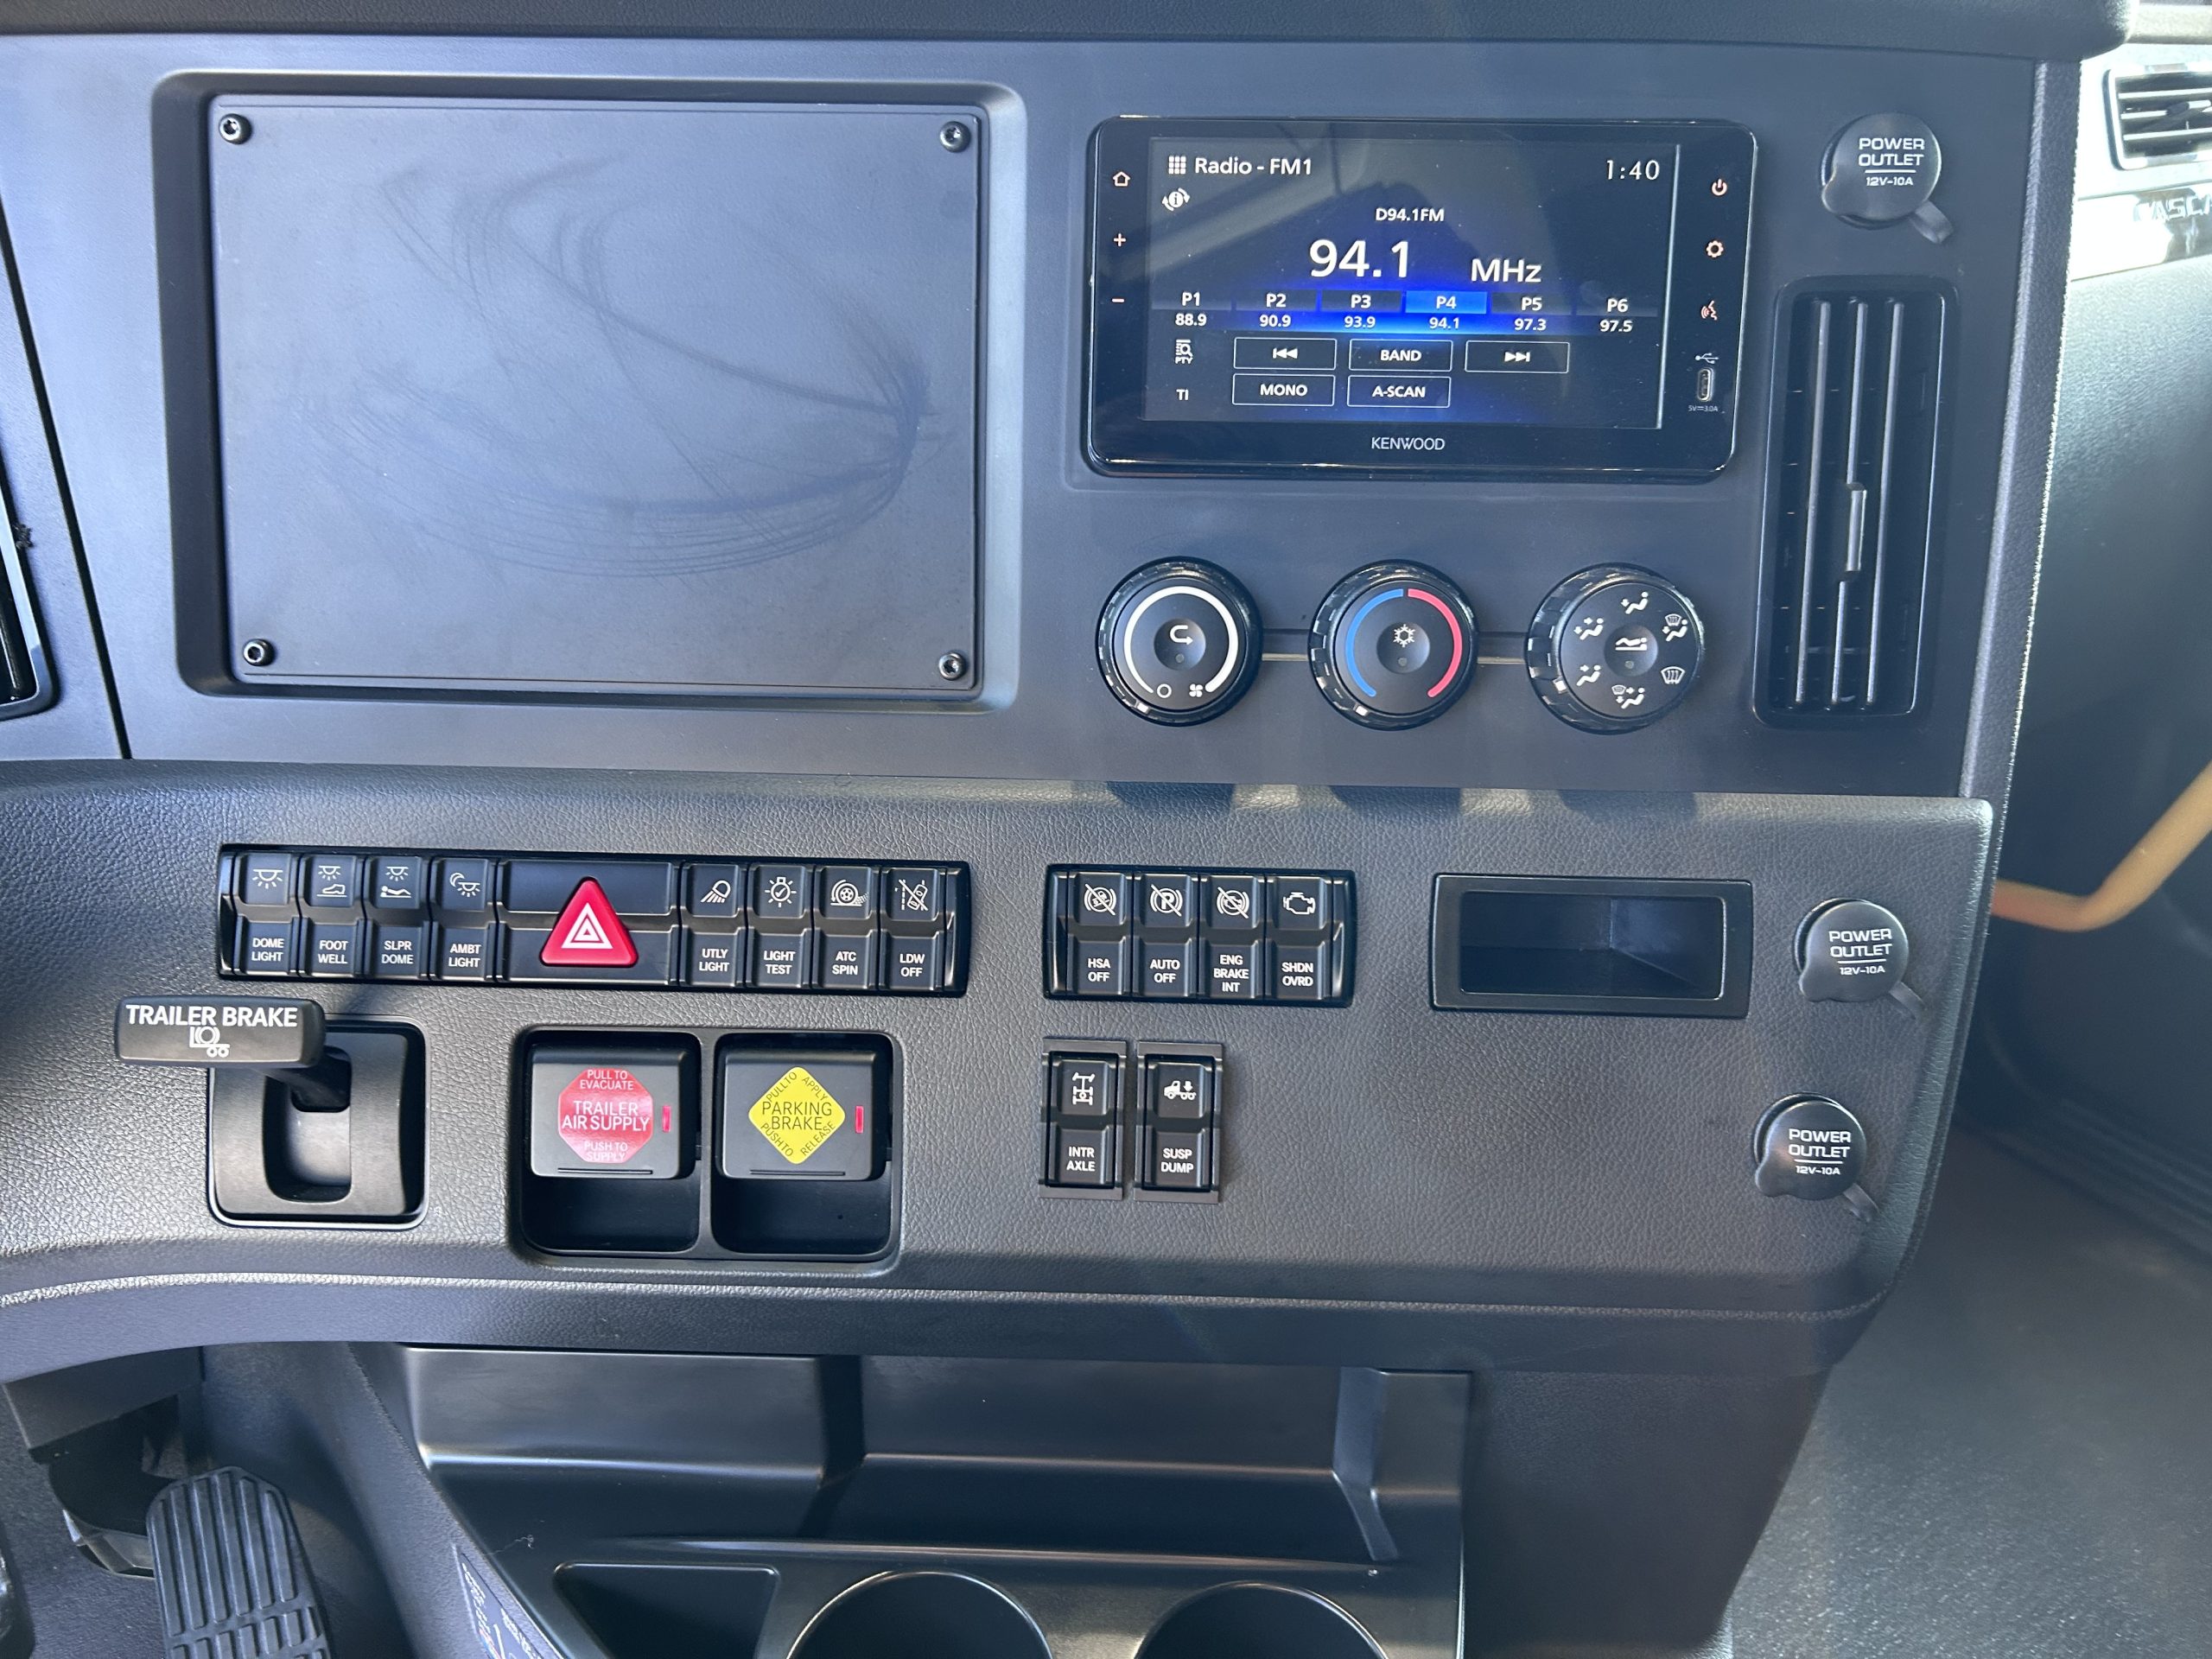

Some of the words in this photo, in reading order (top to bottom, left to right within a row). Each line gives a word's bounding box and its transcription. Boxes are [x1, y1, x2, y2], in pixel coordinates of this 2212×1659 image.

[1859, 137, 1925, 150] POWER
[1858, 153, 1924, 167] OUTLET
[1195, 157, 1252, 174] Radio
[1270, 158, 1311, 175] FM1
[1606, 160, 1660, 180] 1:40
[1866, 176, 1913, 187] 12V-10A
[1376, 207, 1445, 222] D94.1FM
[1309, 239, 1409, 278] 94.1
[1471, 259, 1541, 283] MHz
[1182, 292, 1200, 306] P1
[1266, 294, 1287, 308] P2
[1351, 295, 1371, 308] P3
[1436, 296, 1457, 309] P4
[1522, 297, 1542, 311] P5
[1607, 299, 1629, 312] P6
[1175, 314, 1207, 326] 88.9
[1259, 315, 1291, 327] 90.9
[1344, 316, 1376, 328] 93.9
[1429, 317, 1459, 329] 94.1
[1515, 318, 1547, 331] 97.3
[1599, 320, 1633, 333] 97.5
[1380, 350, 1421, 362] BAND
[1260, 385, 1307, 397] MONO
[1372, 386, 1426, 399] A-SCAN
[1371, 436, 1445, 451] KENWOOD
[1829, 929, 1891, 942] POWER
[252, 938, 283, 948] DOME
[320, 941, 346, 950] FOOT
[385, 941, 411, 951] SLPR
[450, 944, 480, 954] AMBT
[702, 949, 727, 958] UTLY
[1830, 944, 1891, 957] OUTLET
[251, 951, 282, 962] LIGHT
[318, 954, 347, 964] WELL
[382, 955, 413, 964] DOME
[764, 951, 794, 962] LIGHT
[836, 952, 856, 962] ATC
[900, 954, 924, 964] LDW
[1220, 955, 1243, 966] ENG
[448, 957, 480, 968] LIGHT
[699, 962, 729, 972] LIGHT
[1088, 958, 1110, 969] HSA
[1150, 959, 1180, 970] AUTO
[1281, 962, 1313, 973] SHDN
[766, 964, 791, 974] TEST
[832, 964, 858, 975] SPIN
[900, 967, 922, 976] OFF
[1214, 968, 1249, 979] BRAKE
[1840, 966, 1885, 975] 12V-10A
[1088, 972, 1109, 982] OFF
[1154, 973, 1176, 983] OFF
[1282, 976, 1313, 987] OVRD
[1222, 982, 1240, 992] INT
[125, 1004, 217, 1026] TRAILER
[223, 1006, 298, 1027] BRAKE
[588, 1070, 612, 1079] PULL
[614, 1071, 628, 1079] TO
[580, 1080, 633, 1090] EVACUATE
[766, 1084, 788, 1103] PULL
[785, 1071, 798, 1084] TO
[802, 1077, 828, 1101] APPLY
[573, 1101, 639, 1116] TRAILER
[762, 1101, 832, 1116] PARKING
[562, 1116, 588, 1130] AIR
[590, 1116, 650, 1131] SUPPLY
[772, 1116, 823, 1131] BRAKE
[760, 1122, 784, 1147] PUSH
[781, 1142, 794, 1157] TO
[800, 1121, 836, 1156] RELEASE
[1789, 1128, 1852, 1143] POWER
[584, 1141, 612, 1151] PUSH
[615, 1141, 628, 1152] TO
[1788, 1144, 1851, 1158] OUTLET
[586, 1152, 626, 1160] SUPPLY
[1068, 1147, 1095, 1158] INTR
[1162, 1147, 1192, 1160] SUSP
[1066, 1160, 1096, 1172] AXLE
[1160, 1162, 1194, 1173] DUMP
[1796, 1165, 1840, 1175] 12V-10A
